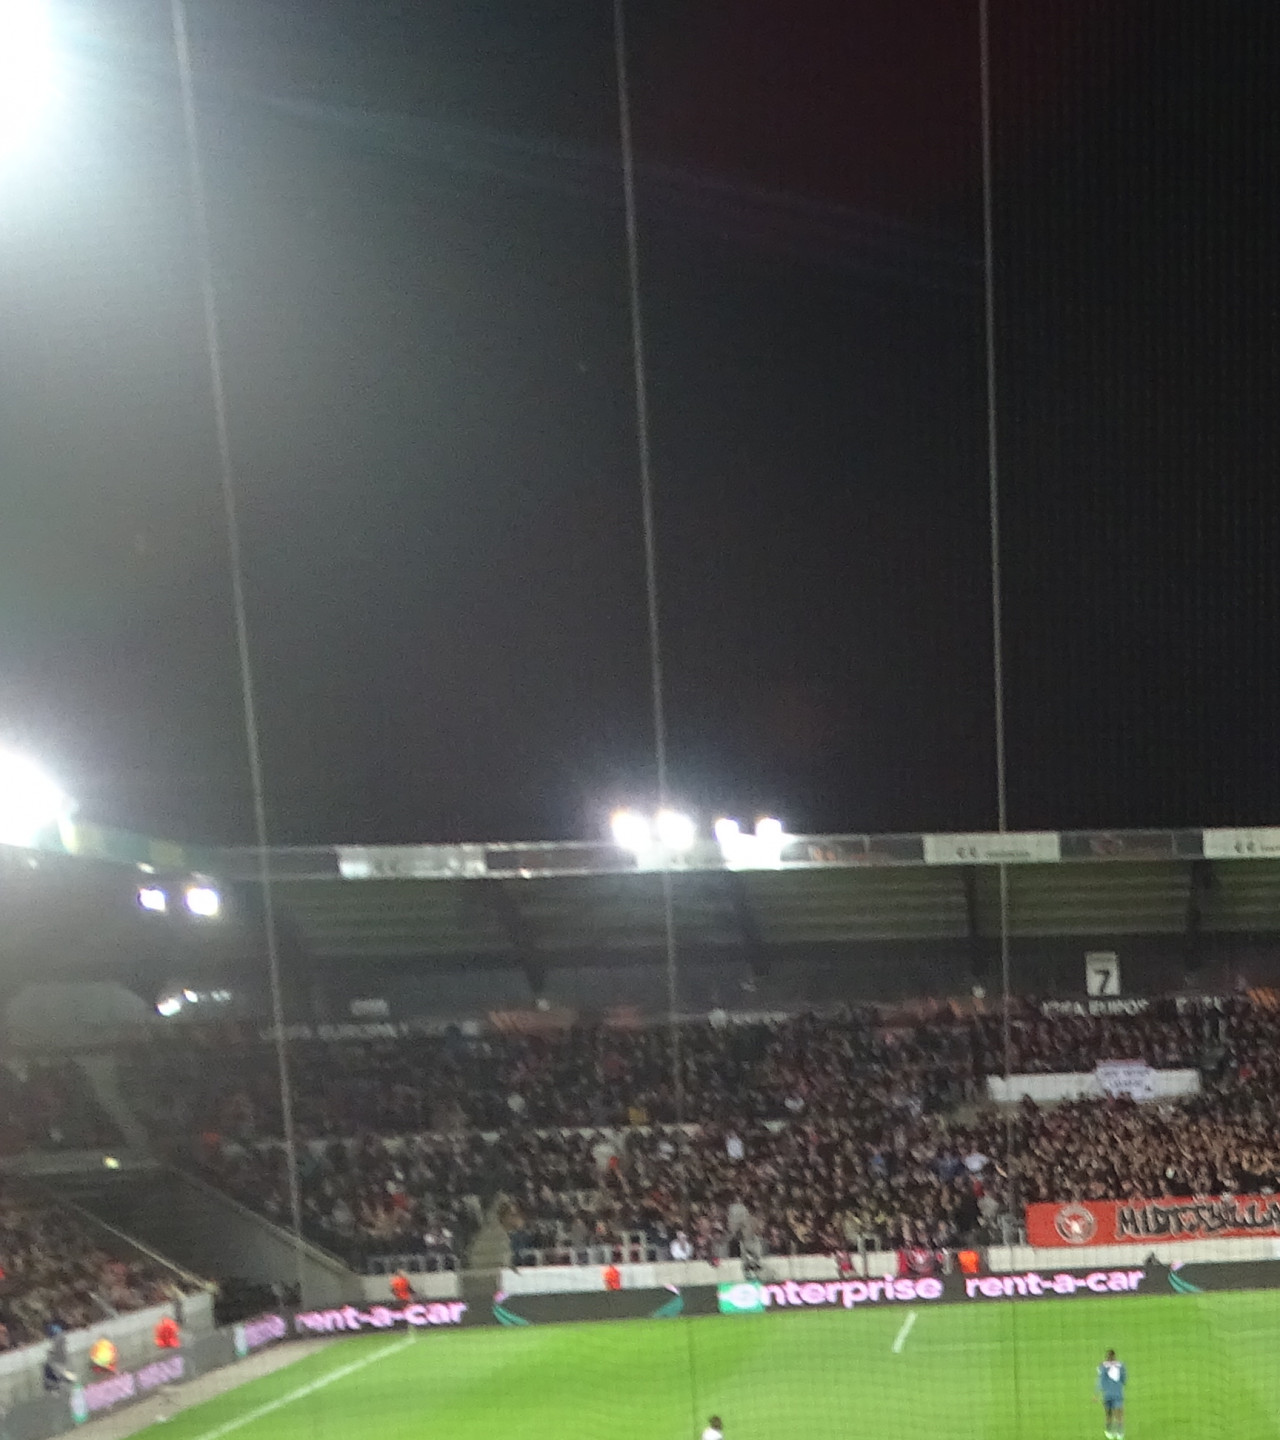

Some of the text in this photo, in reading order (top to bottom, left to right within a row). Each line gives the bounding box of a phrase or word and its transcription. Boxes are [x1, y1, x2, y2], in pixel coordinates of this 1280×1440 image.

[1094, 969, 1111, 995] 7
[728, 1270, 1146, 1308] enterprise rent-a-car
